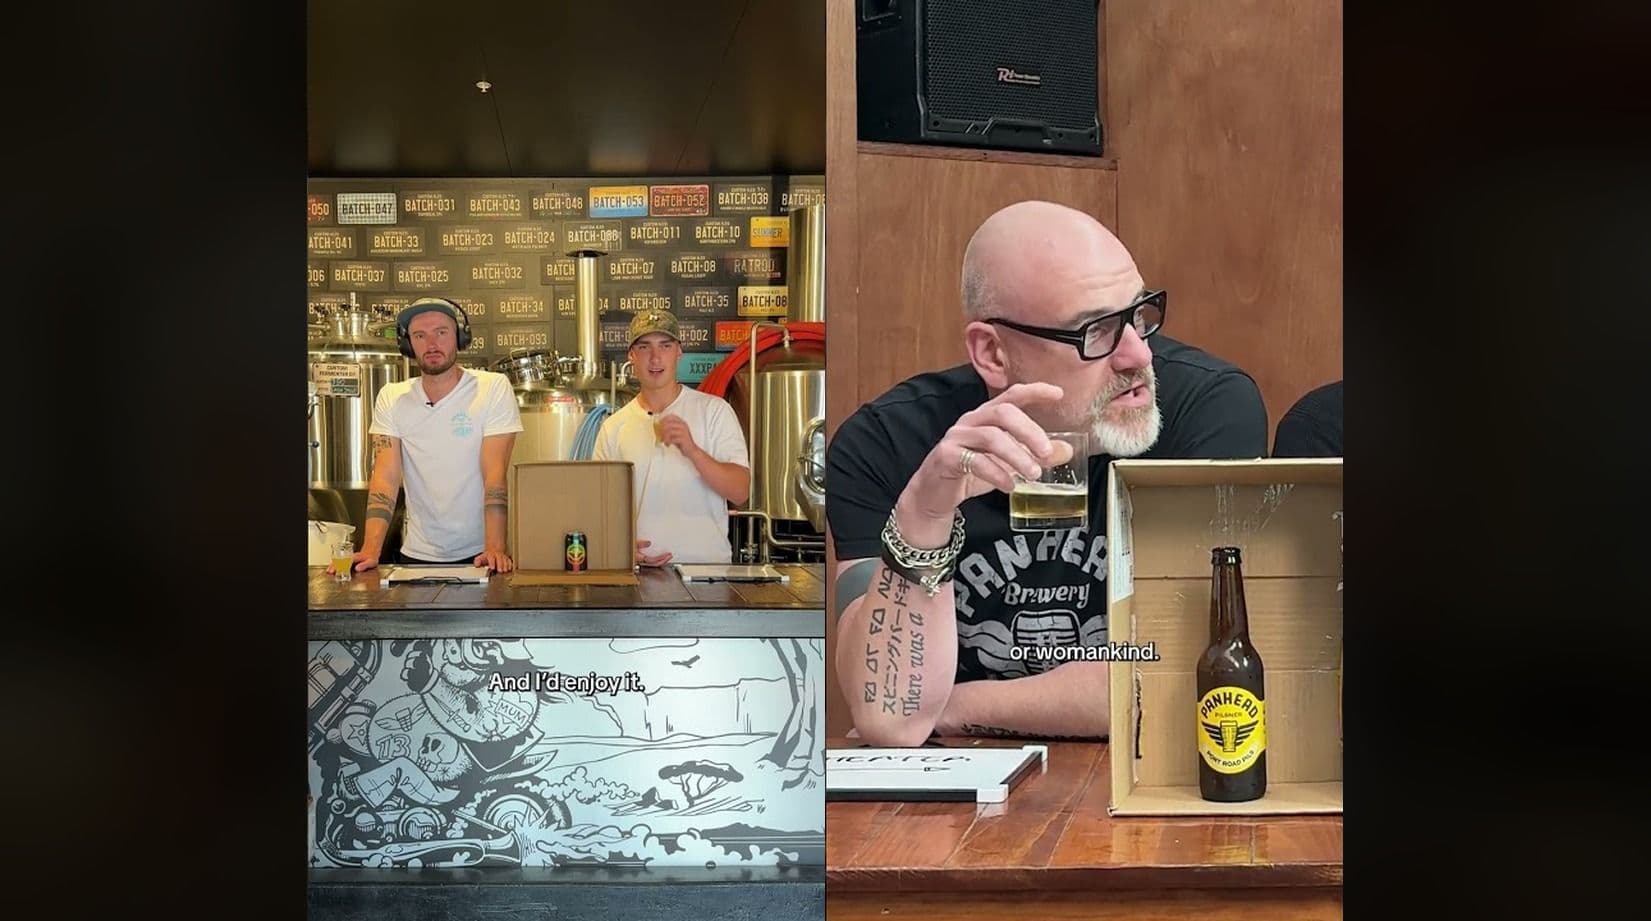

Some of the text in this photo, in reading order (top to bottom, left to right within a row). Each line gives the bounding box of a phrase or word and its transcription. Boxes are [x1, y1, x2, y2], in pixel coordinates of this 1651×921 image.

[1004, 583, 1090, 609] Brewery
[901, 610, 925, 717] There was a
[500, 702, 527, 724] MUM
[1200, 691, 1259, 719] PANHEAD
[376, 734, 411, 761] 13
[1222, 759, 1241, 767] ROAD
